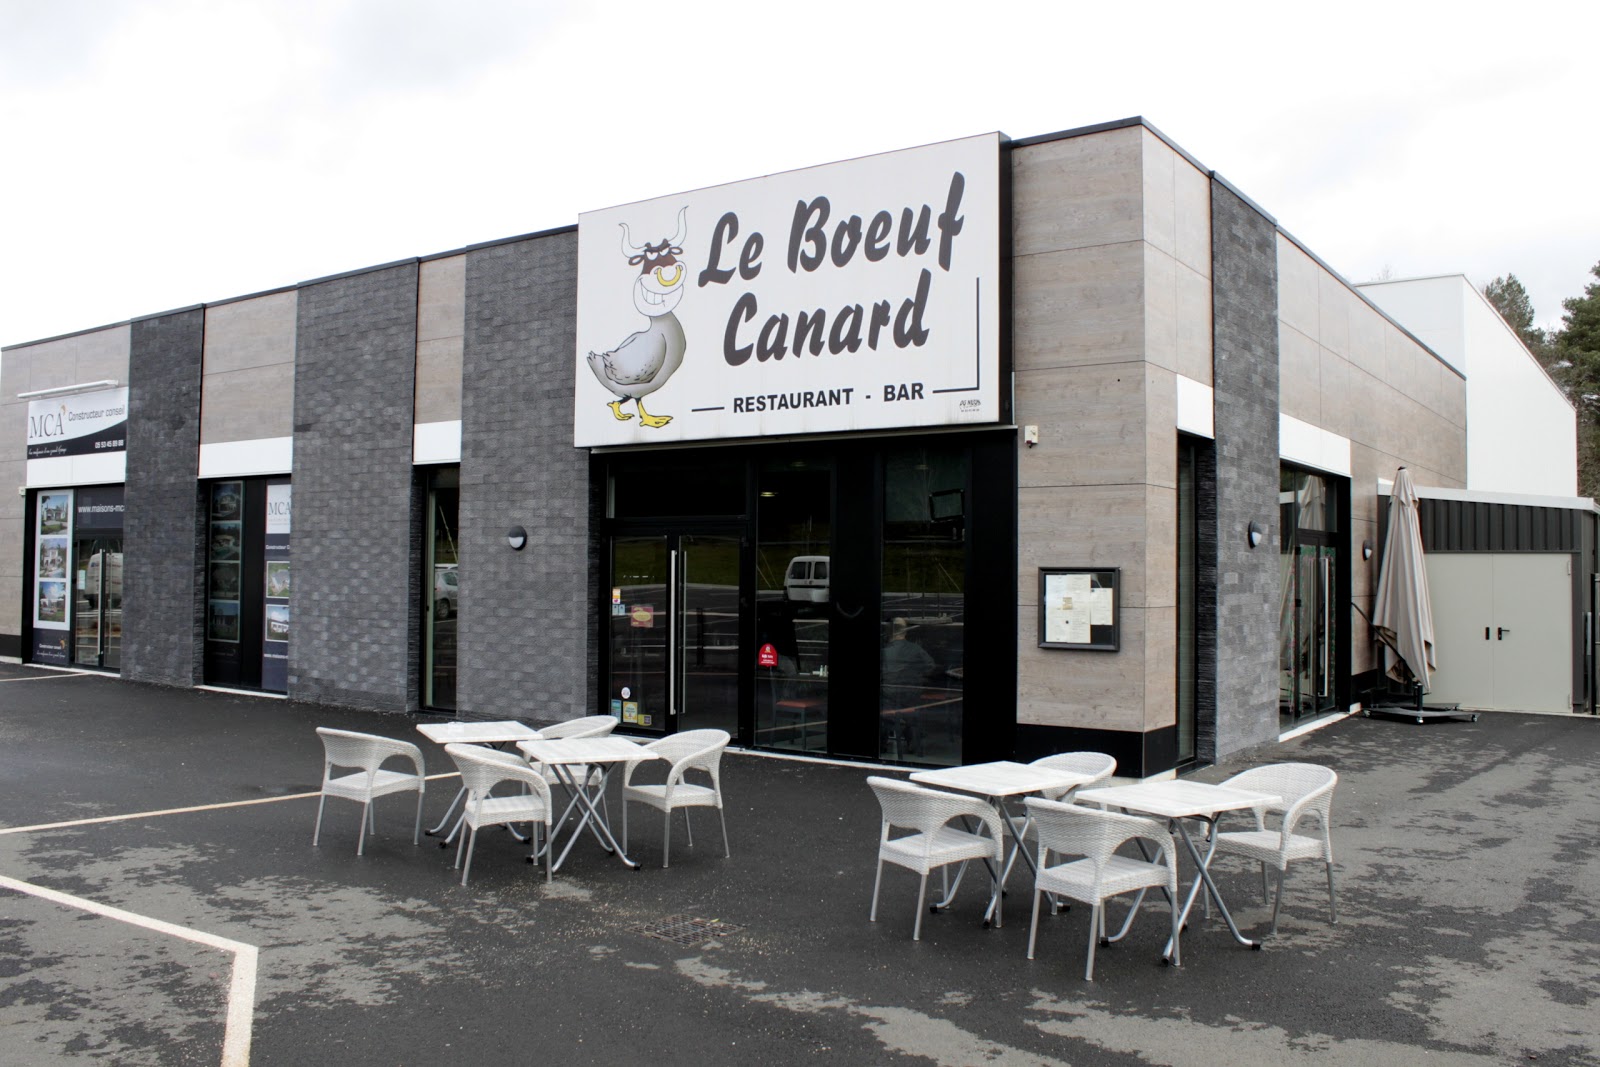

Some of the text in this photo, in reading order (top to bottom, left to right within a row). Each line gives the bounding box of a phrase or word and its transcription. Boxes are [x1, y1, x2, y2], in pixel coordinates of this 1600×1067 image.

[698, 172, 965, 287] Le Boeuf
[724, 268, 932, 367] Canard
[69, 405, 125, 422] Constructeur conseil
[733, 387, 855, 414] RESTAURANT
[883, 382, 924, 402] BAR
[30, 413, 64, 439] MCA
